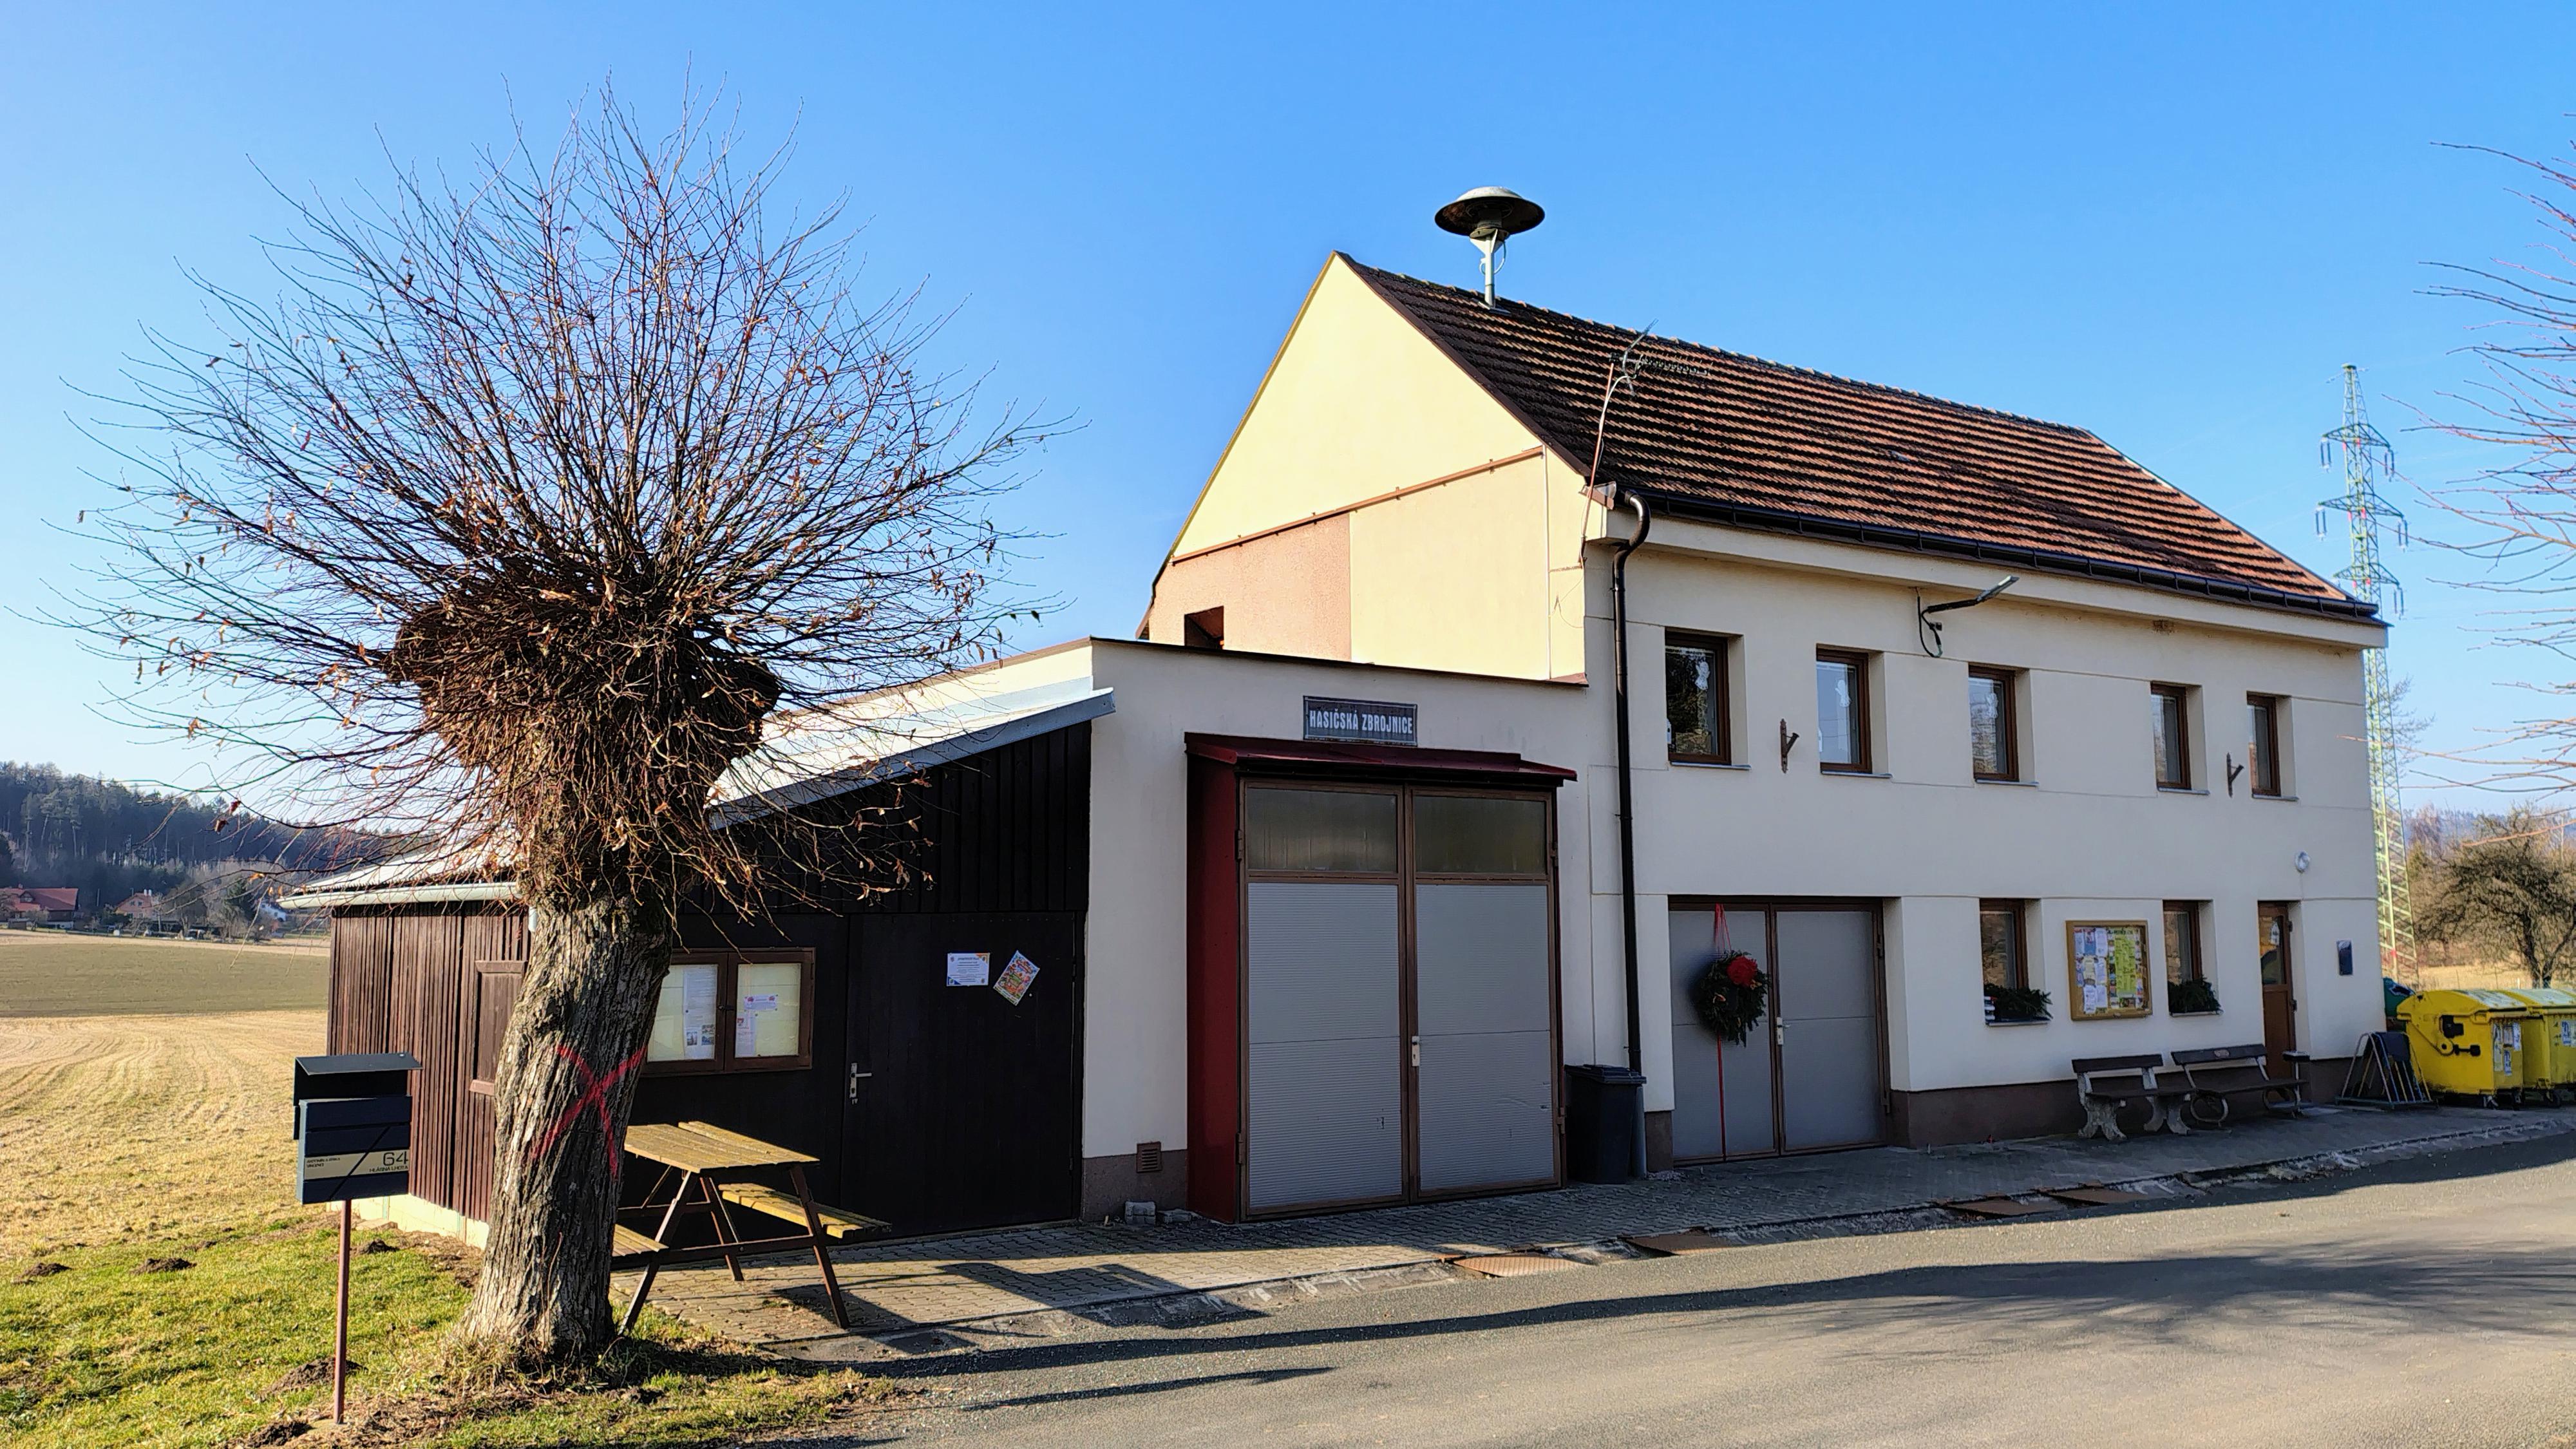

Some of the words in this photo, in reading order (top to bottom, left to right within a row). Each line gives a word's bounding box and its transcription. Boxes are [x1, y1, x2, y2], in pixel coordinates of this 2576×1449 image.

[1310, 708, 1358, 730] HASIČSKÁ
[1361, 714, 1412, 734] ZBROJNICE
[383, 1151, 408, 1166] 64
